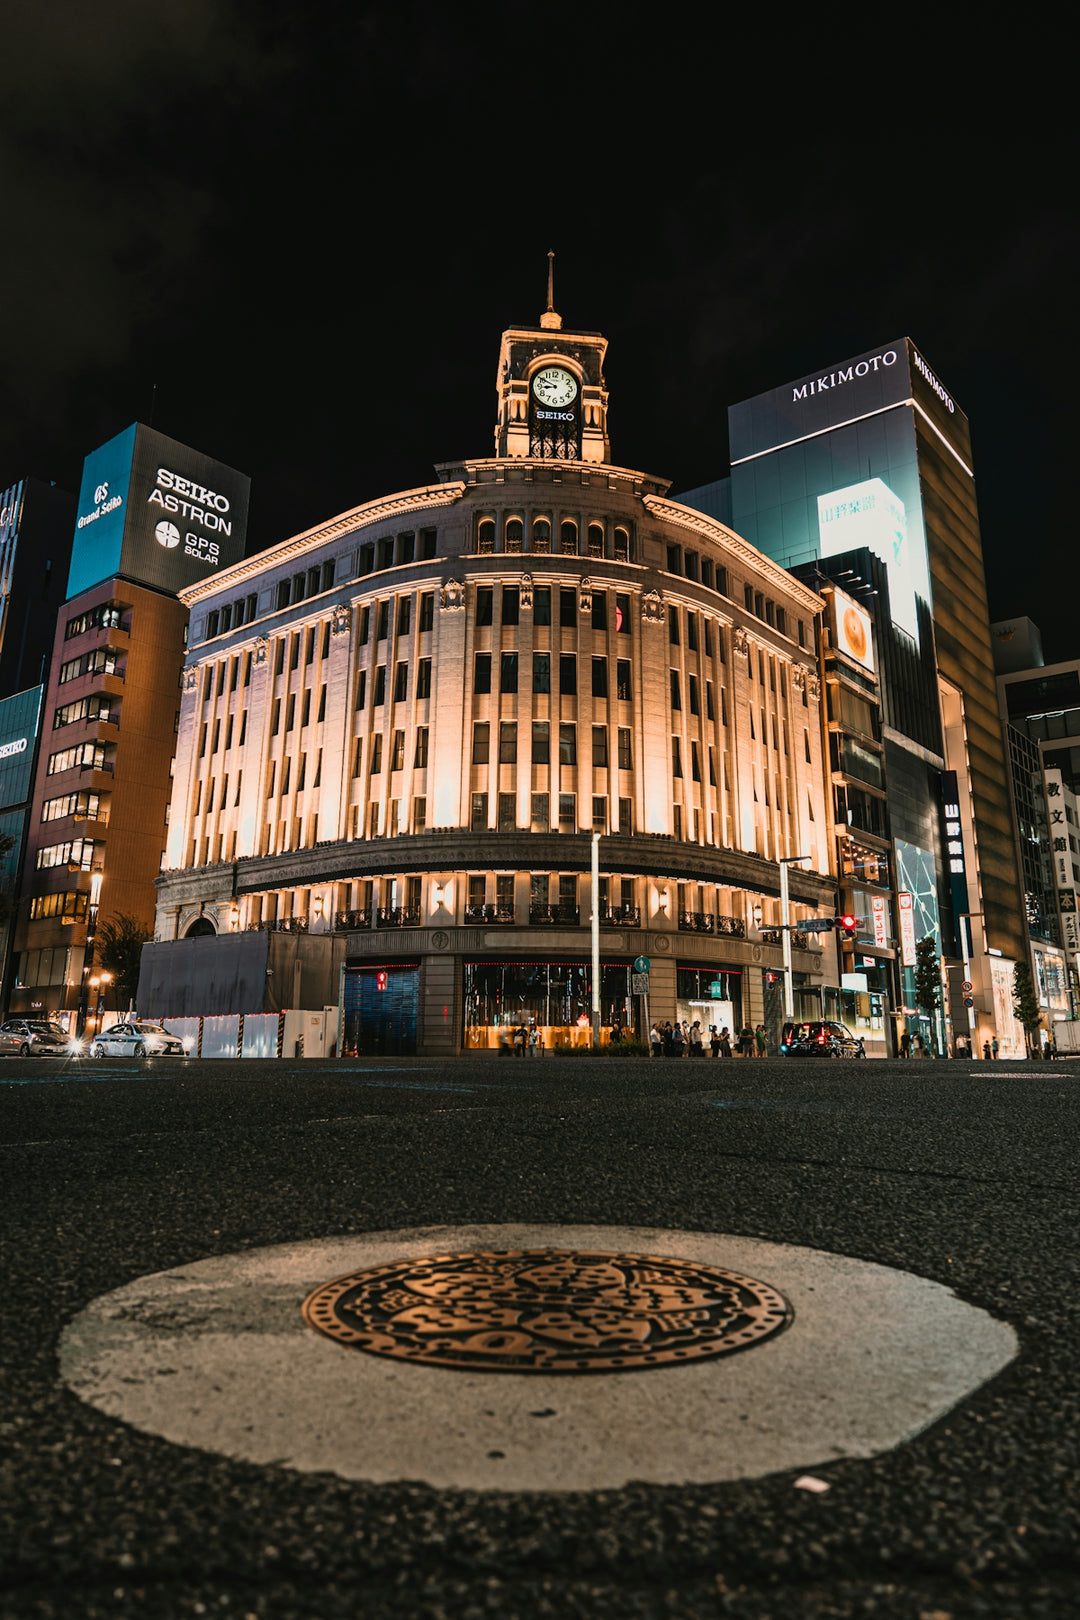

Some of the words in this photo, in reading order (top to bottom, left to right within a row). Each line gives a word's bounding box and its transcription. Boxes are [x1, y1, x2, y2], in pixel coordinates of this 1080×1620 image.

[552, 371, 559, 379] 12
[792, 350, 897, 402] MIKIMOTO
[914, 351, 955, 414] MIKIMOTO
[536, 411, 575, 421] SEIKO
[552, 397, 558, 405] 6
[156, 468, 230, 513] SEIKO
[77, 509, 100, 530] Grand
[100, 495, 123, 516] Seiko
[147, 488, 232, 537] ASTRON
[184, 545, 219, 566] SOLAR
[185, 532, 220, 557] GPS
[1047, 782, 1067, 853] 教文館
[1060, 892, 1073, 909] 本
